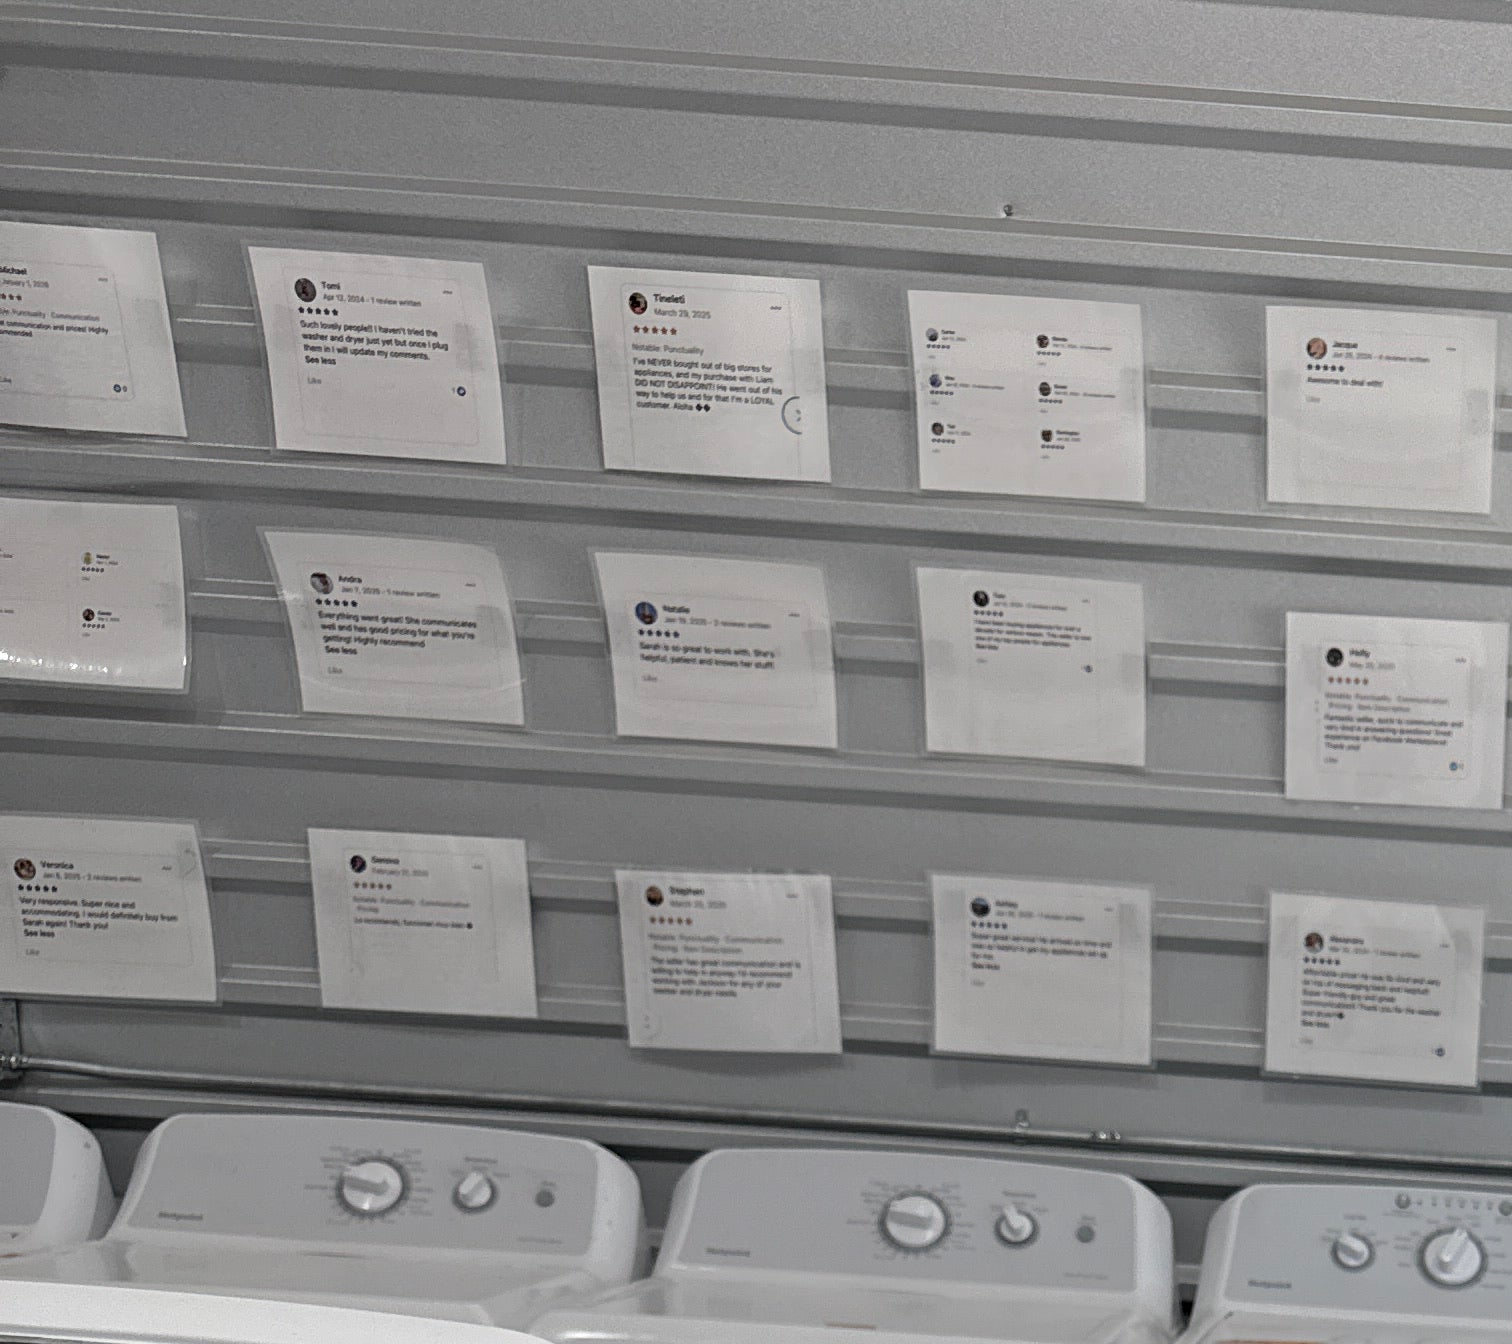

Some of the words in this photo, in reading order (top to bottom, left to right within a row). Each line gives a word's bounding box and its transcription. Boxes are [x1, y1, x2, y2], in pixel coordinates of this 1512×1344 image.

[321, 322, 341, 331] lovely
[408, 328, 423, 336] tried
[346, 336, 363, 344] dryer
[432, 342, 448, 351] plug
[318, 611, 359, 622] Everything
